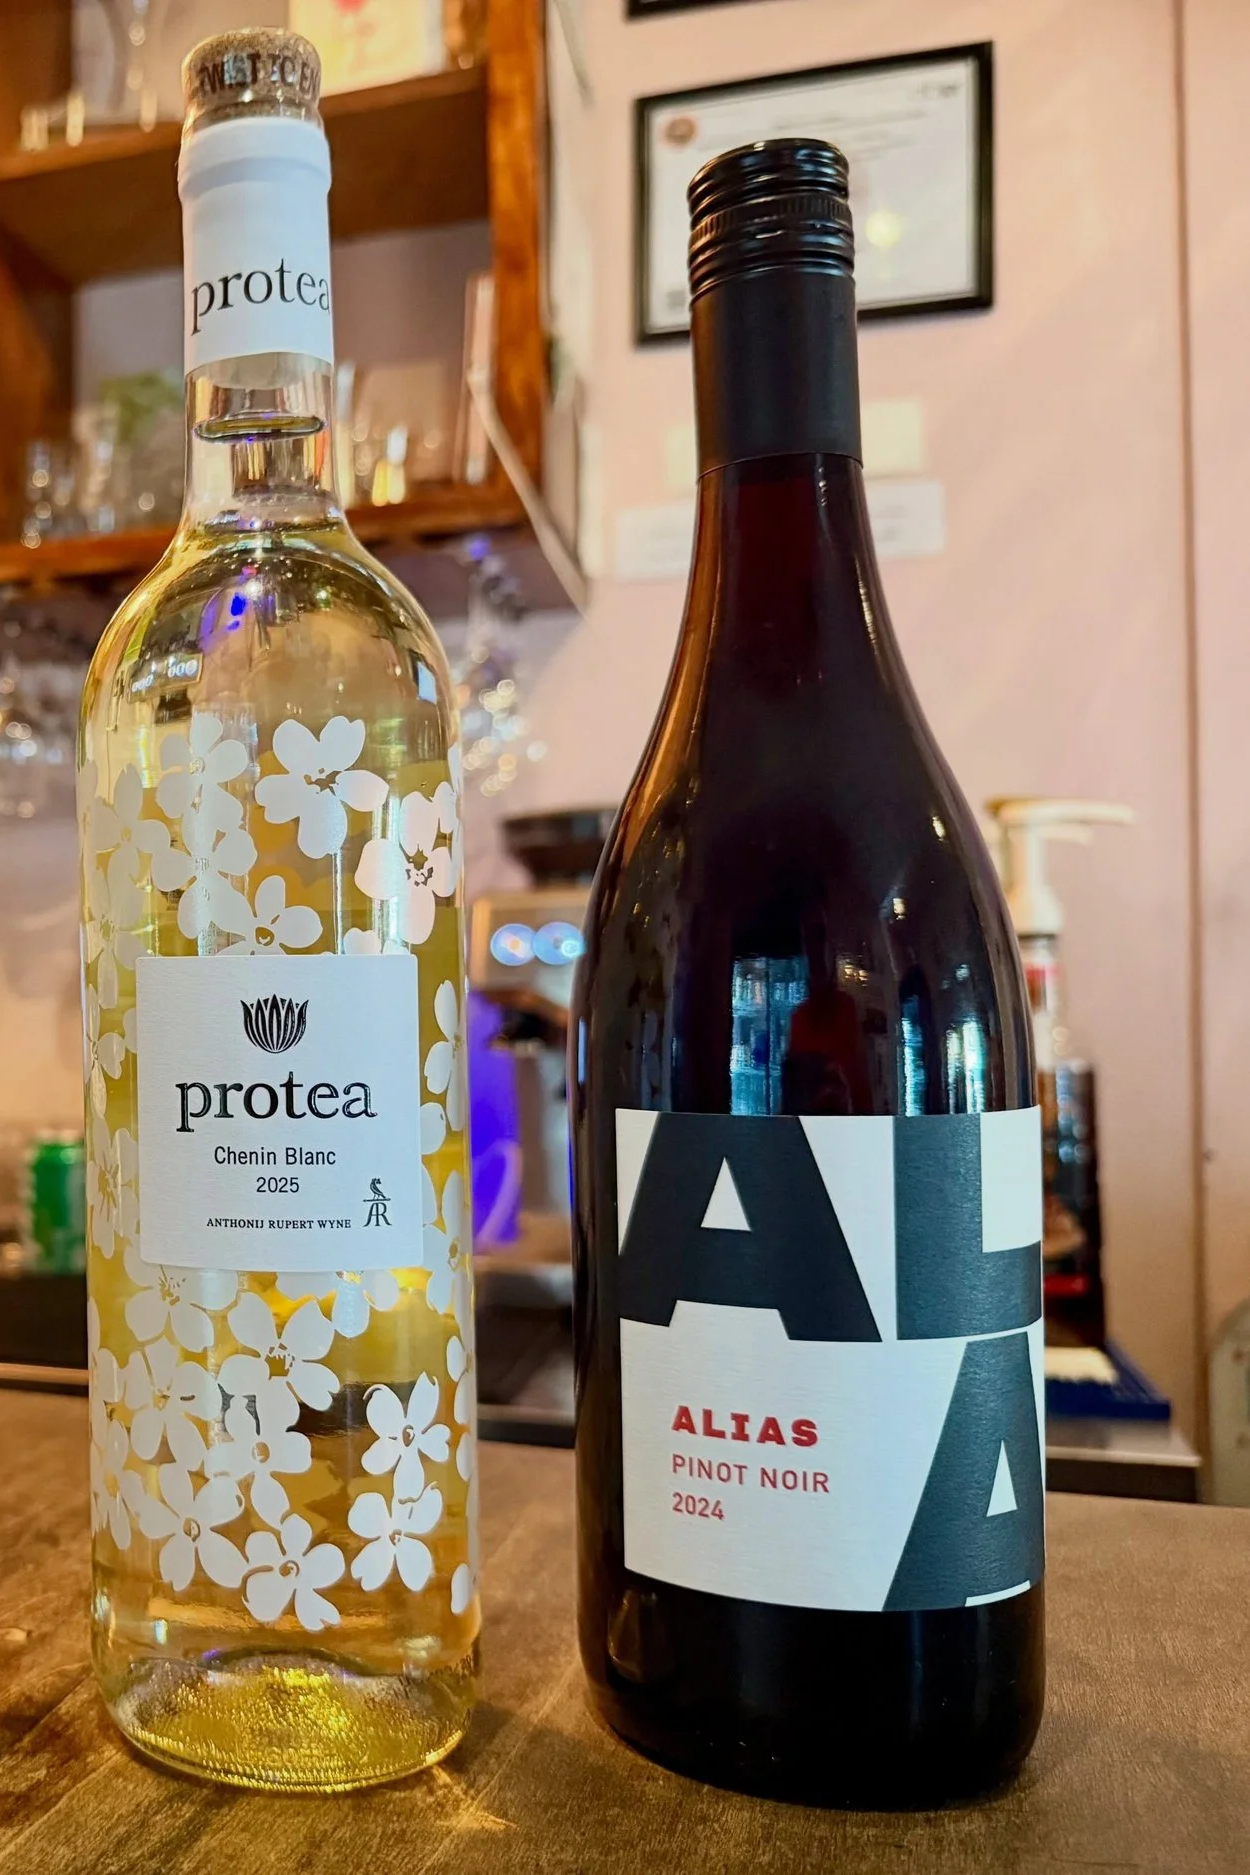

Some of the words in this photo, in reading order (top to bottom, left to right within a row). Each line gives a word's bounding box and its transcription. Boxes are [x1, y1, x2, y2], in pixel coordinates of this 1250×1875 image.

[267, 53, 296, 87] TO
[175, 1071, 378, 1132] protea
[214, 1146, 277, 1165] Chenin
[285, 1147, 336, 1165] Blanc
[256, 1176, 300, 1193] 2025
[207, 1217, 264, 1229] ANTHONIJ
[268, 1219, 314, 1230] RUPERT
[317, 1219, 351, 1230] WYNE
[671, 1404, 819, 1447] ALIAS
[672, 1453, 748, 1486] PINOT
[759, 1467, 830, 1493] NOIR
[672, 1492, 724, 1521] 2024
